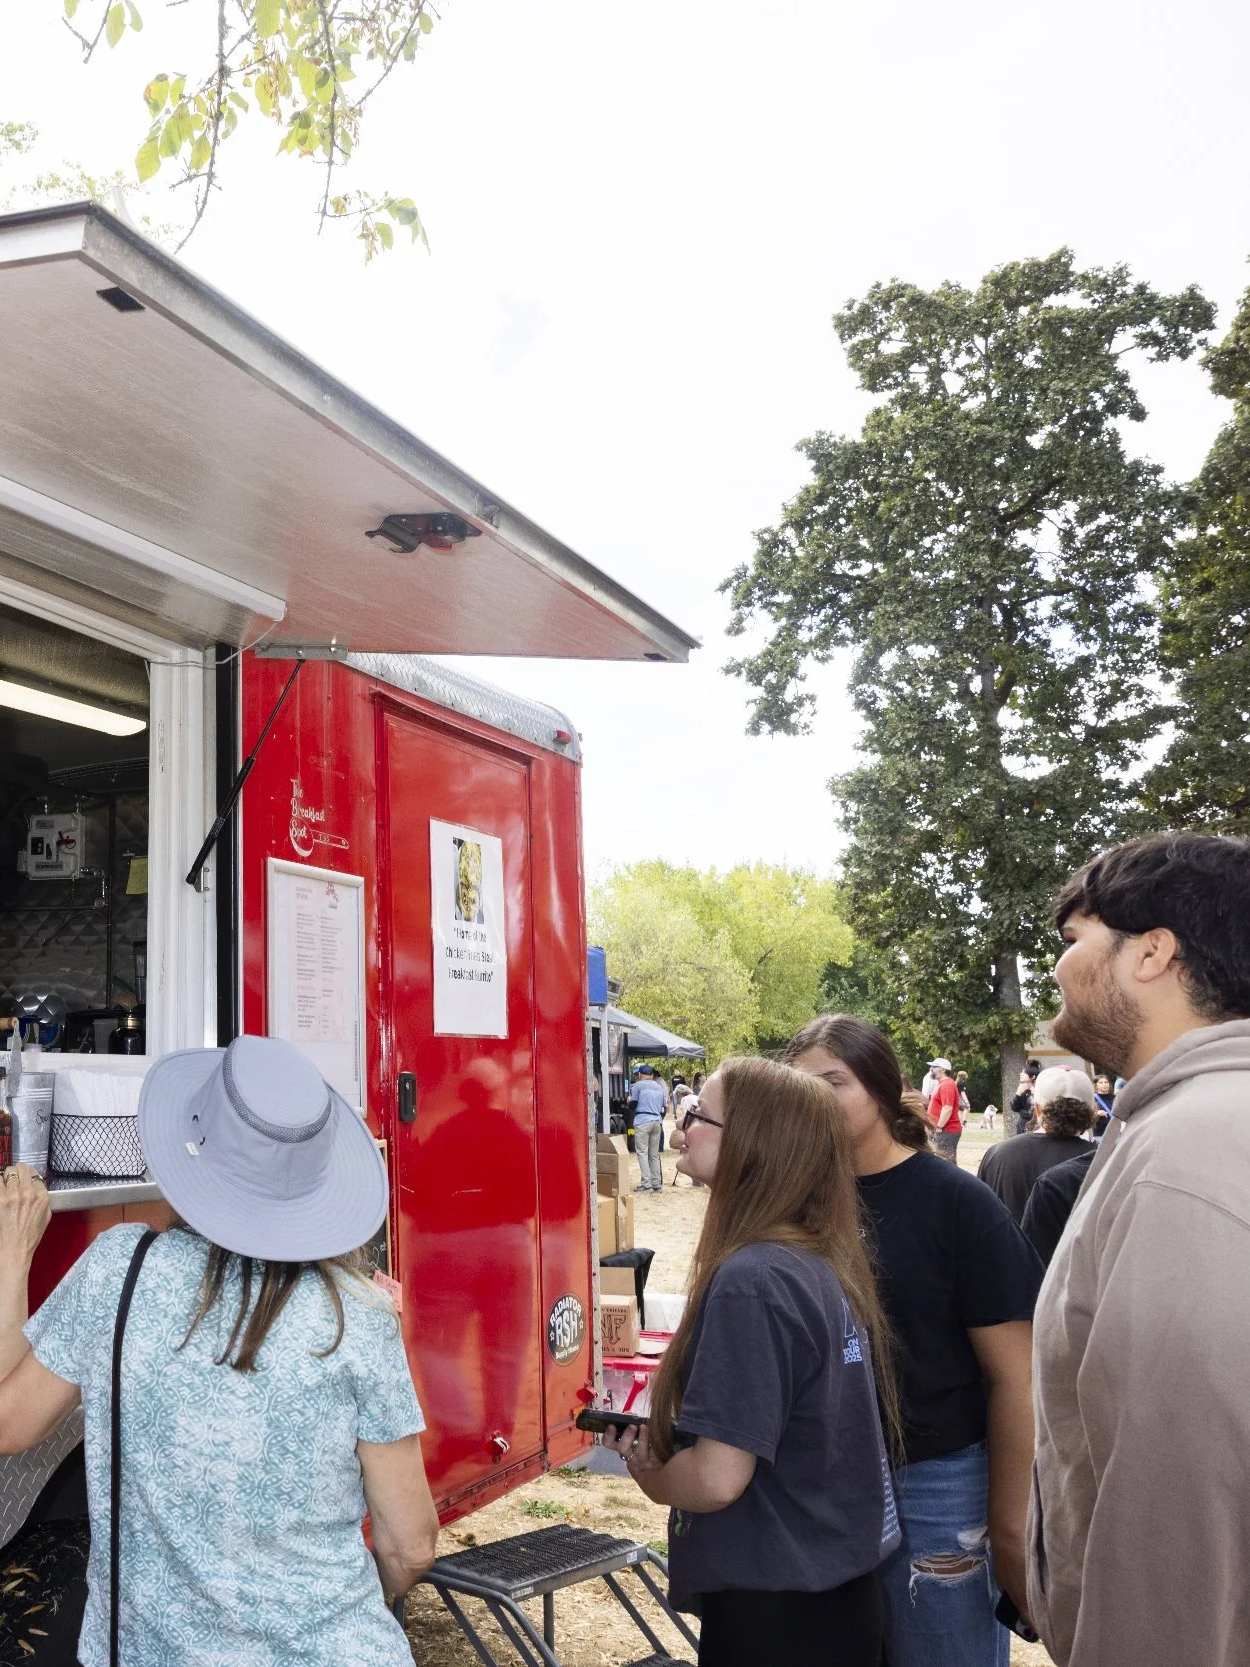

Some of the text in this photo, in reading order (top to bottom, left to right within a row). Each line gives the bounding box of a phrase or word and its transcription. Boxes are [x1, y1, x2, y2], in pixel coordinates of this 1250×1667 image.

[291, 778, 303, 798] The
[291, 798, 325, 822] Breakfast
[291, 818, 308, 838] Spot
[446, 946, 466, 959] Chicken
[550, 1296, 582, 1327] RADIATOR
[556, 1310, 578, 1347] RSH
[843, 1346, 861, 1356] TOUR
[848, 1338, 859, 1347] ON
[844, 1354, 862, 1365] 2025
